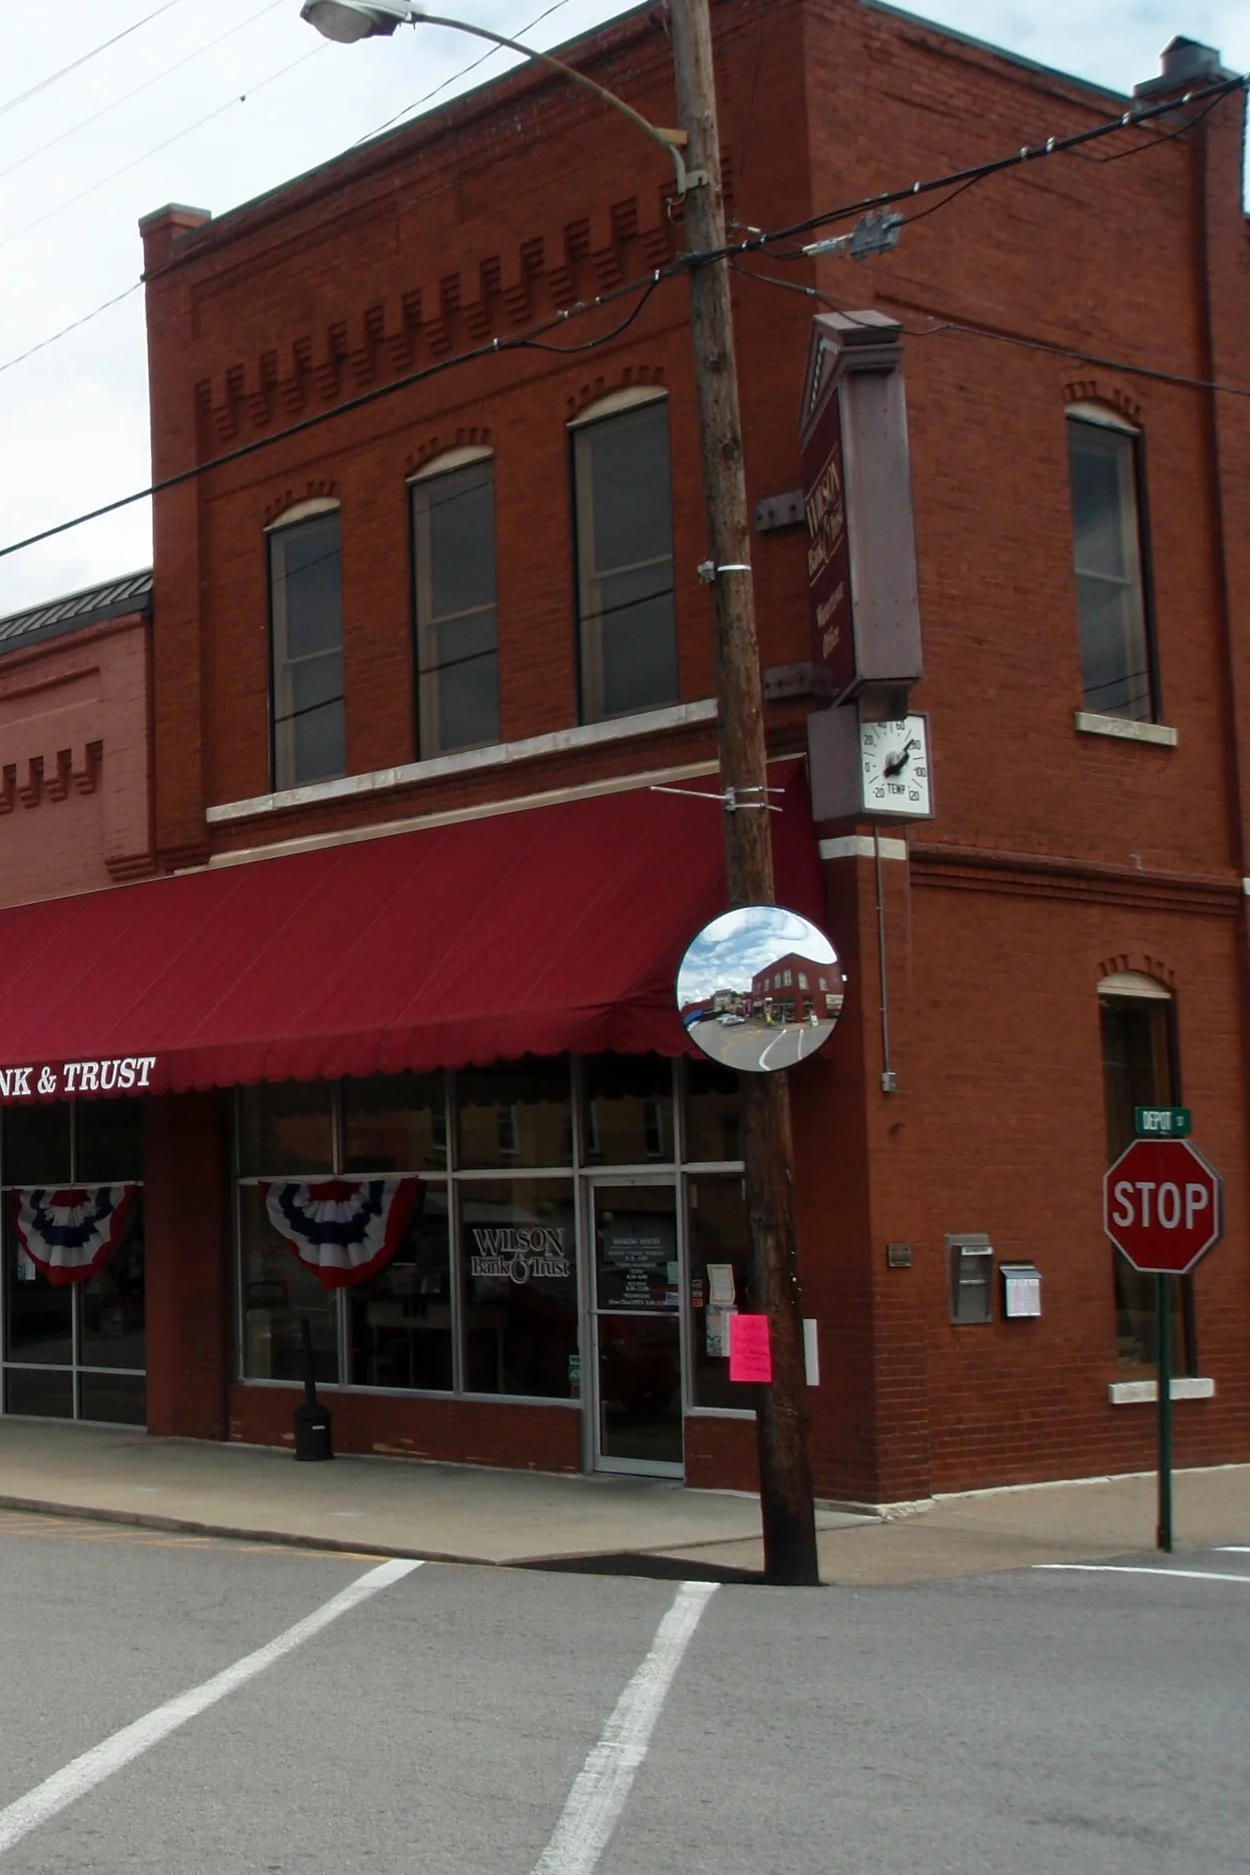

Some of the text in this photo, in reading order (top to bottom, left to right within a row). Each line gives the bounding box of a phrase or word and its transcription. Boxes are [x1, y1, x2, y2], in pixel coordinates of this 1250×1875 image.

[864, 734, 874, 746] 20
[864, 761, 870, 773] 0
[887, 783, 905, 795] TEMP
[37, 1066, 57, 1094] &
[63, 1057, 156, 1091] TRUST
[1142, 1111, 1171, 1130] DEPOT
[1112, 1181, 1208, 1230] STOP
[472, 1227, 565, 1256] WILSON
[471, 1255, 511, 1276] Bank
[529, 1256, 570, 1278] Trust
